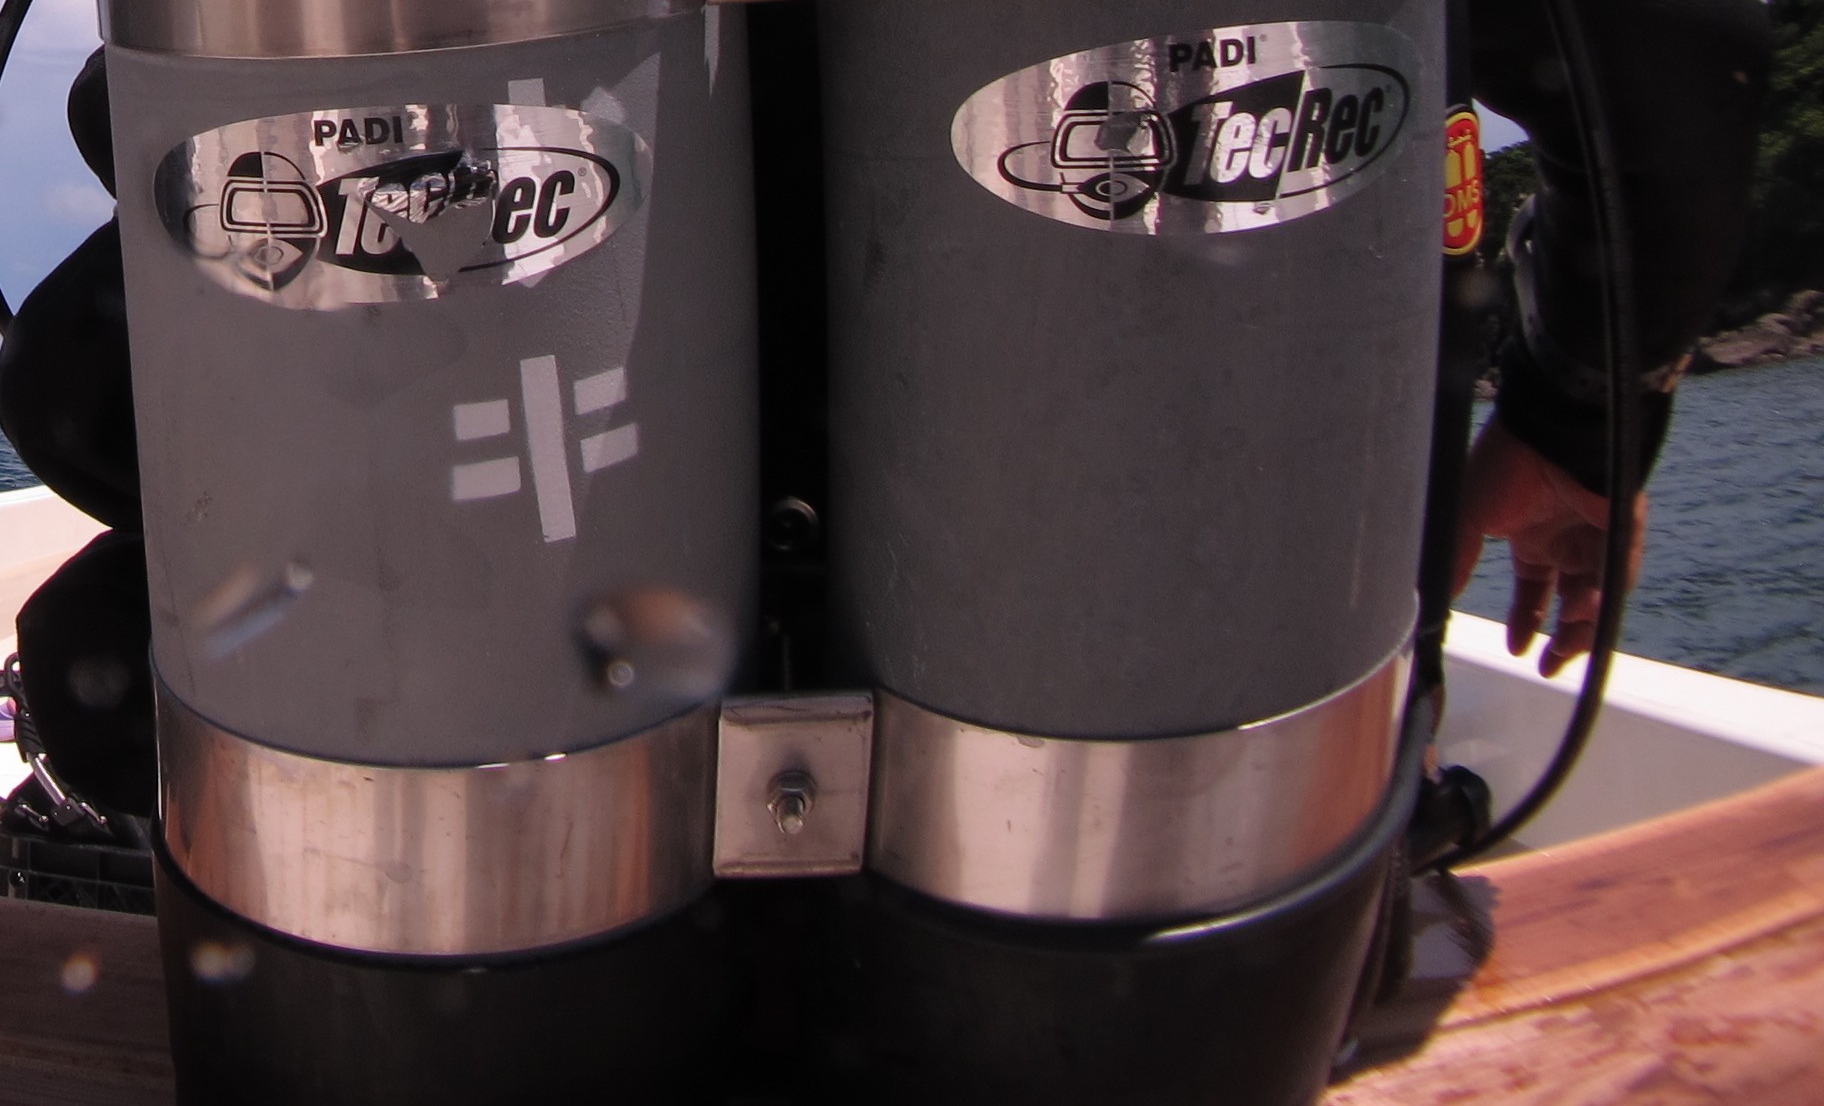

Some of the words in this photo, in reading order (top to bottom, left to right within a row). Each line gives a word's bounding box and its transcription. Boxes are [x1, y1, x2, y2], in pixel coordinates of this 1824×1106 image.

[1168, 36, 1258, 73] PADI
[313, 115, 404, 147] PADI
[1182, 86, 1385, 186] TecRec
